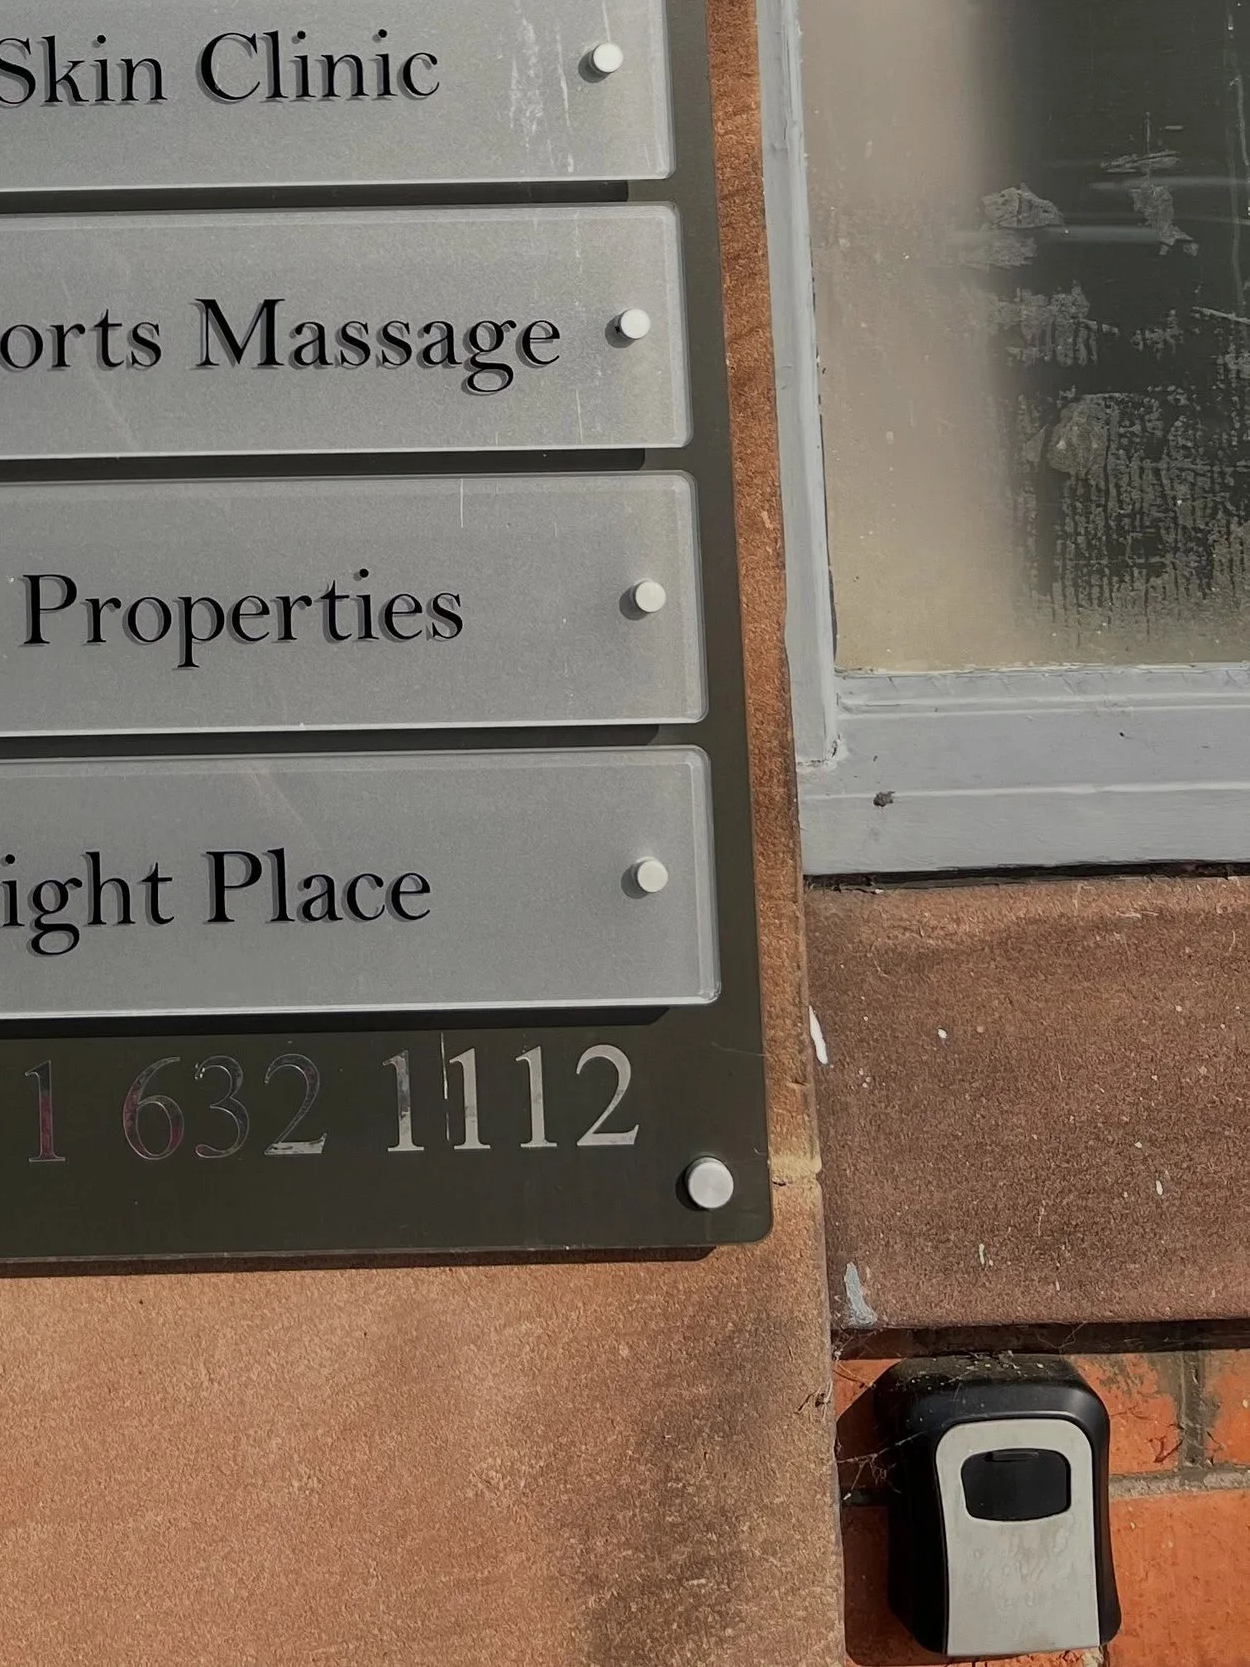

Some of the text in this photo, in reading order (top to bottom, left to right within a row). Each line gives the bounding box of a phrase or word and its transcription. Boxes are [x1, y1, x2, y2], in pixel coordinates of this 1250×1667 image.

[201, 29, 439, 102] Clinic
[195, 299, 560, 396] Massage
[23, 569, 462, 668] Properties
[206, 848, 430, 922] Place
[121, 1056, 327, 1162] 632
[382, 1042, 640, 1154] 1112
